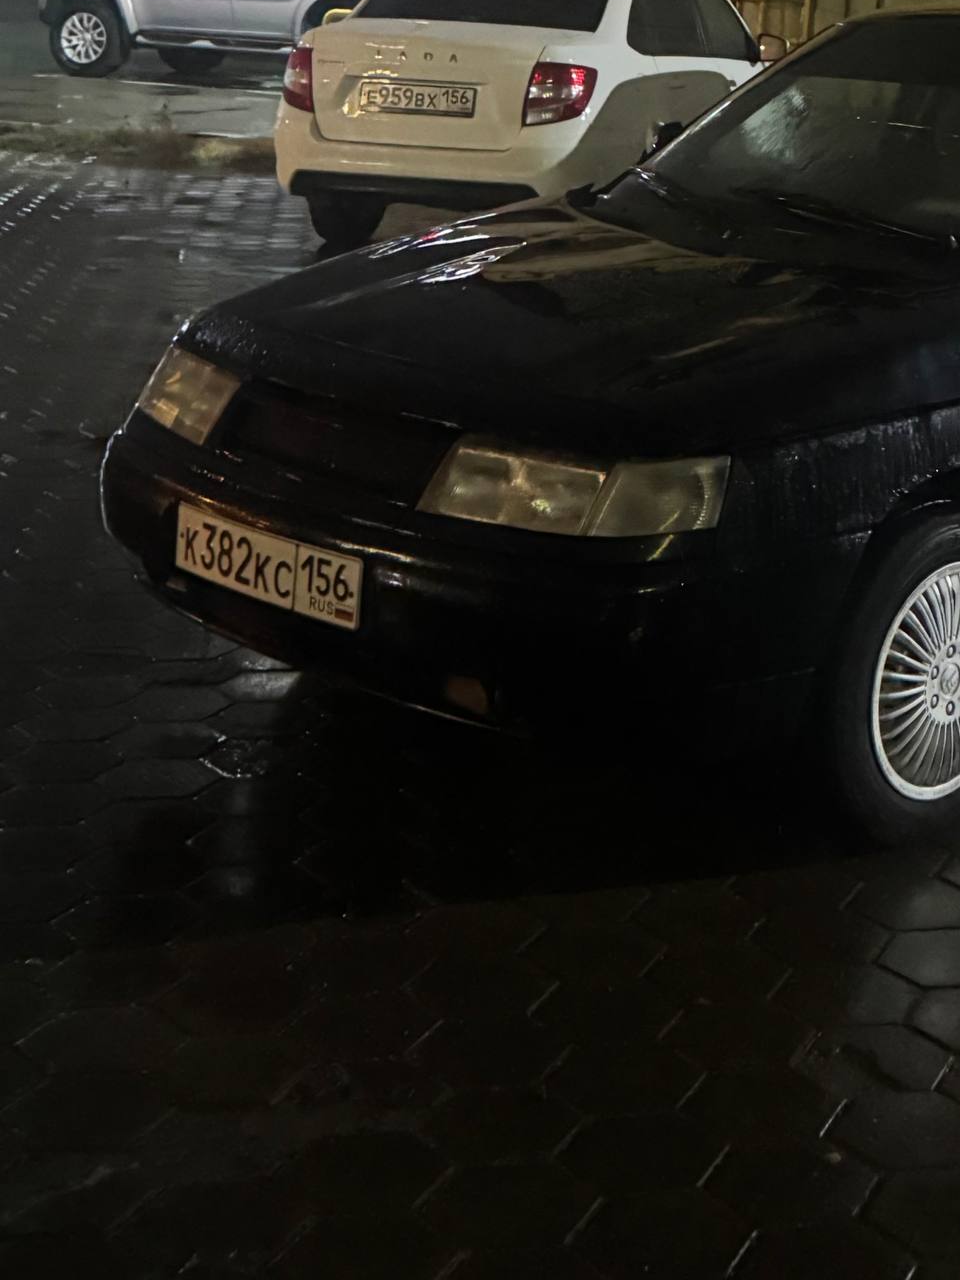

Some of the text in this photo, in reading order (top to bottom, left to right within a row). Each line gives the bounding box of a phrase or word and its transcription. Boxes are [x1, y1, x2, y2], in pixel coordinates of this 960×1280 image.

[441, 88, 470, 106] 156
[184, 522, 350, 602] К382КС 156
[308, 595, 335, 616] RUS
